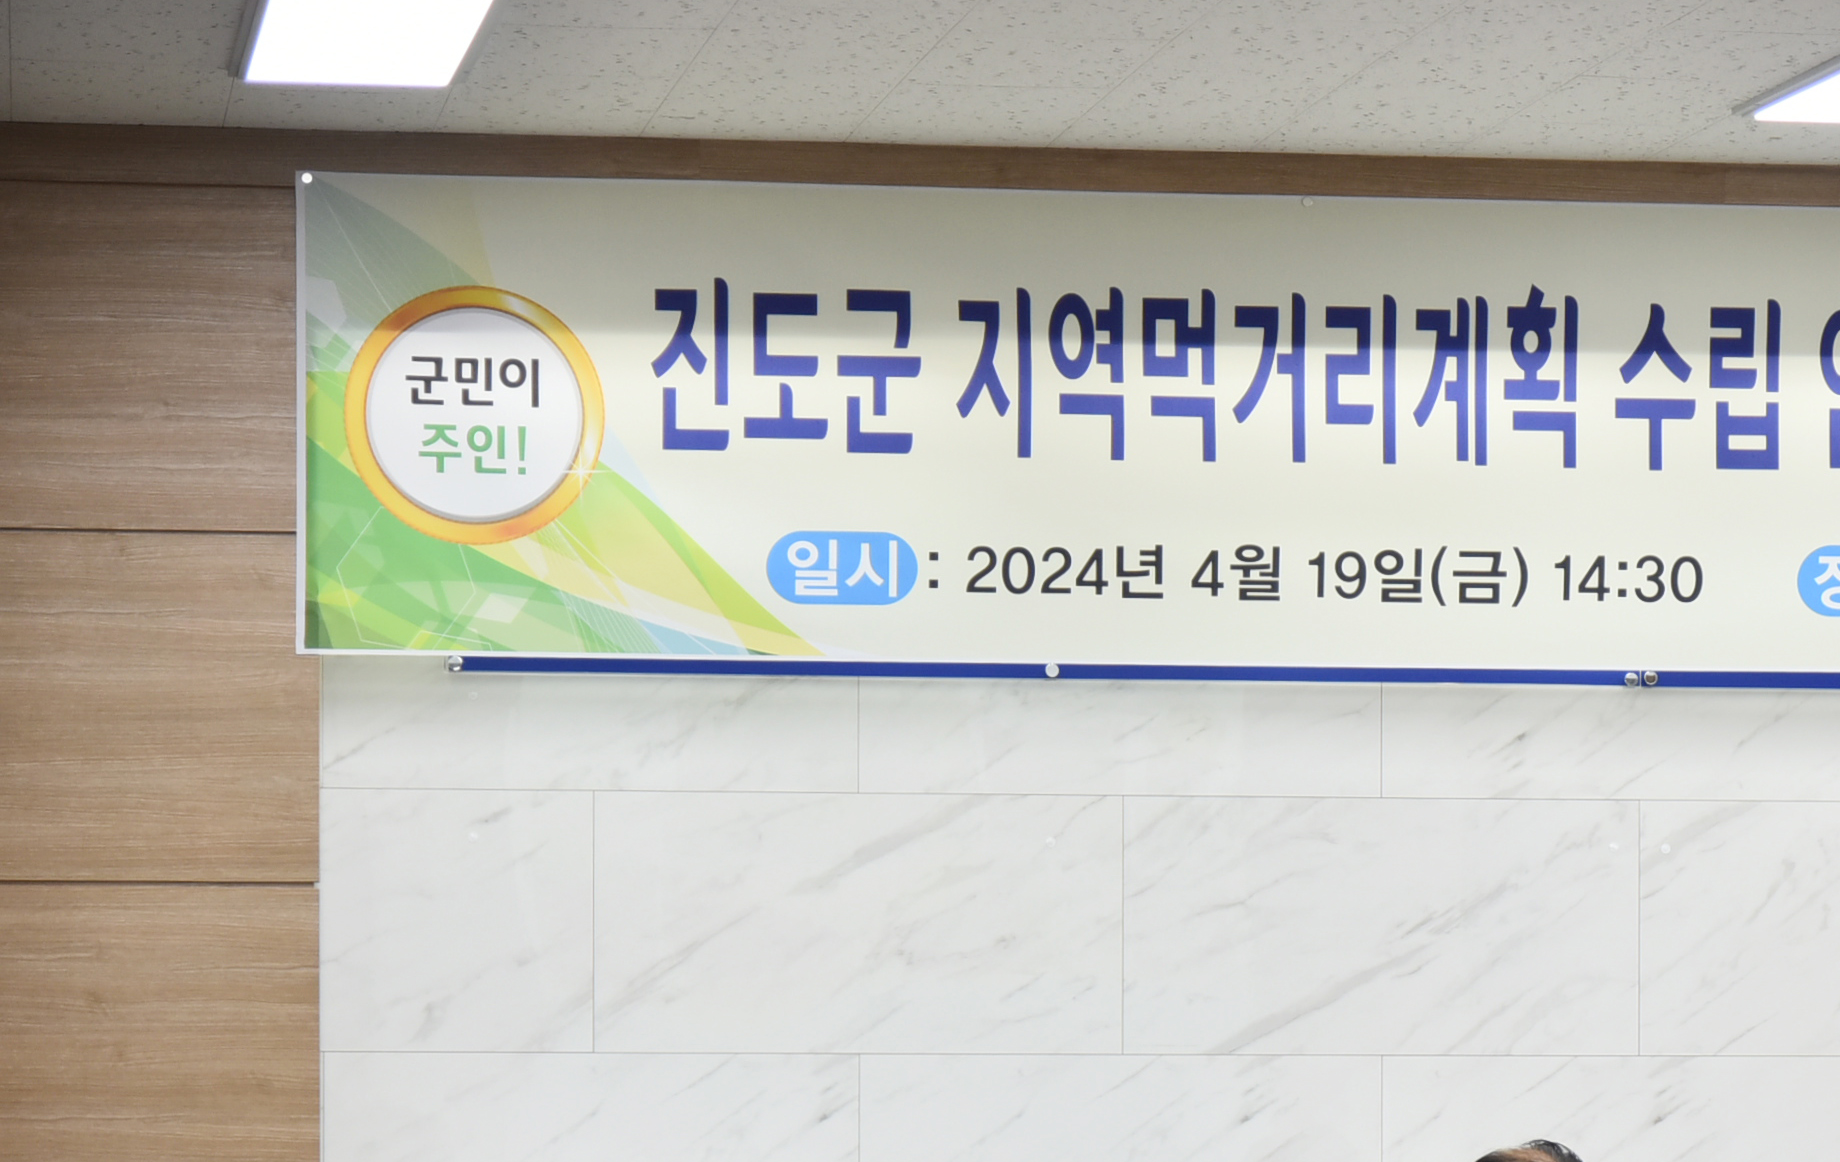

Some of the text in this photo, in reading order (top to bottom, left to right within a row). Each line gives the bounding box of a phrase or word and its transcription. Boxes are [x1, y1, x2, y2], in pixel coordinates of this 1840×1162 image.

[404, 352, 542, 407] 군민이
[651, 279, 922, 455] 진도군
[956, 284, 1580, 469] 지역먹거리계획
[1616, 298, 1783, 472] 수립
[418, 422, 530, 477] 주인!
[965, 545, 1165, 600] 2024년
[1191, 544, 1281, 602] 4월
[1308, 546, 1529, 608] 19일(금)
[1554, 554, 1704, 604] 14:30
